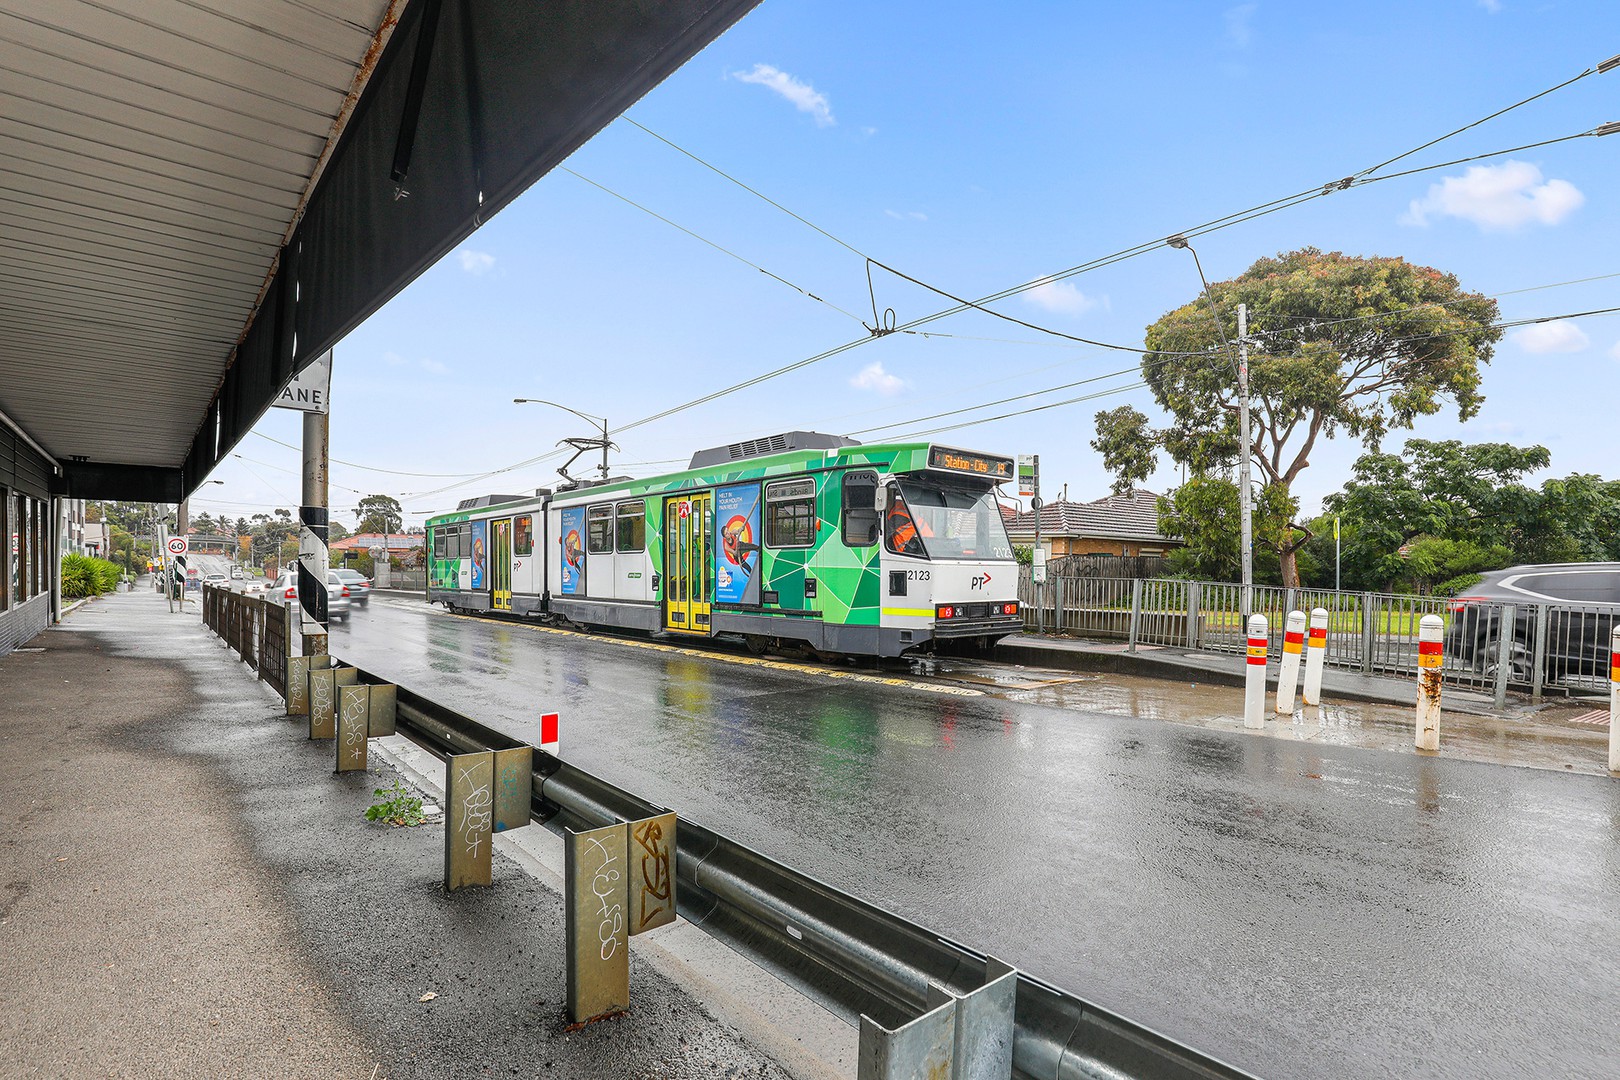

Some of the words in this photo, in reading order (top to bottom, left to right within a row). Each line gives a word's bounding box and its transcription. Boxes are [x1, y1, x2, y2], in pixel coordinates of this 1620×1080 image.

[171, 542, 184, 550] 60
[993, 548, 1013, 558] 2123
[907, 570, 931, 581] 2123
[971, 577, 985, 590] PT
